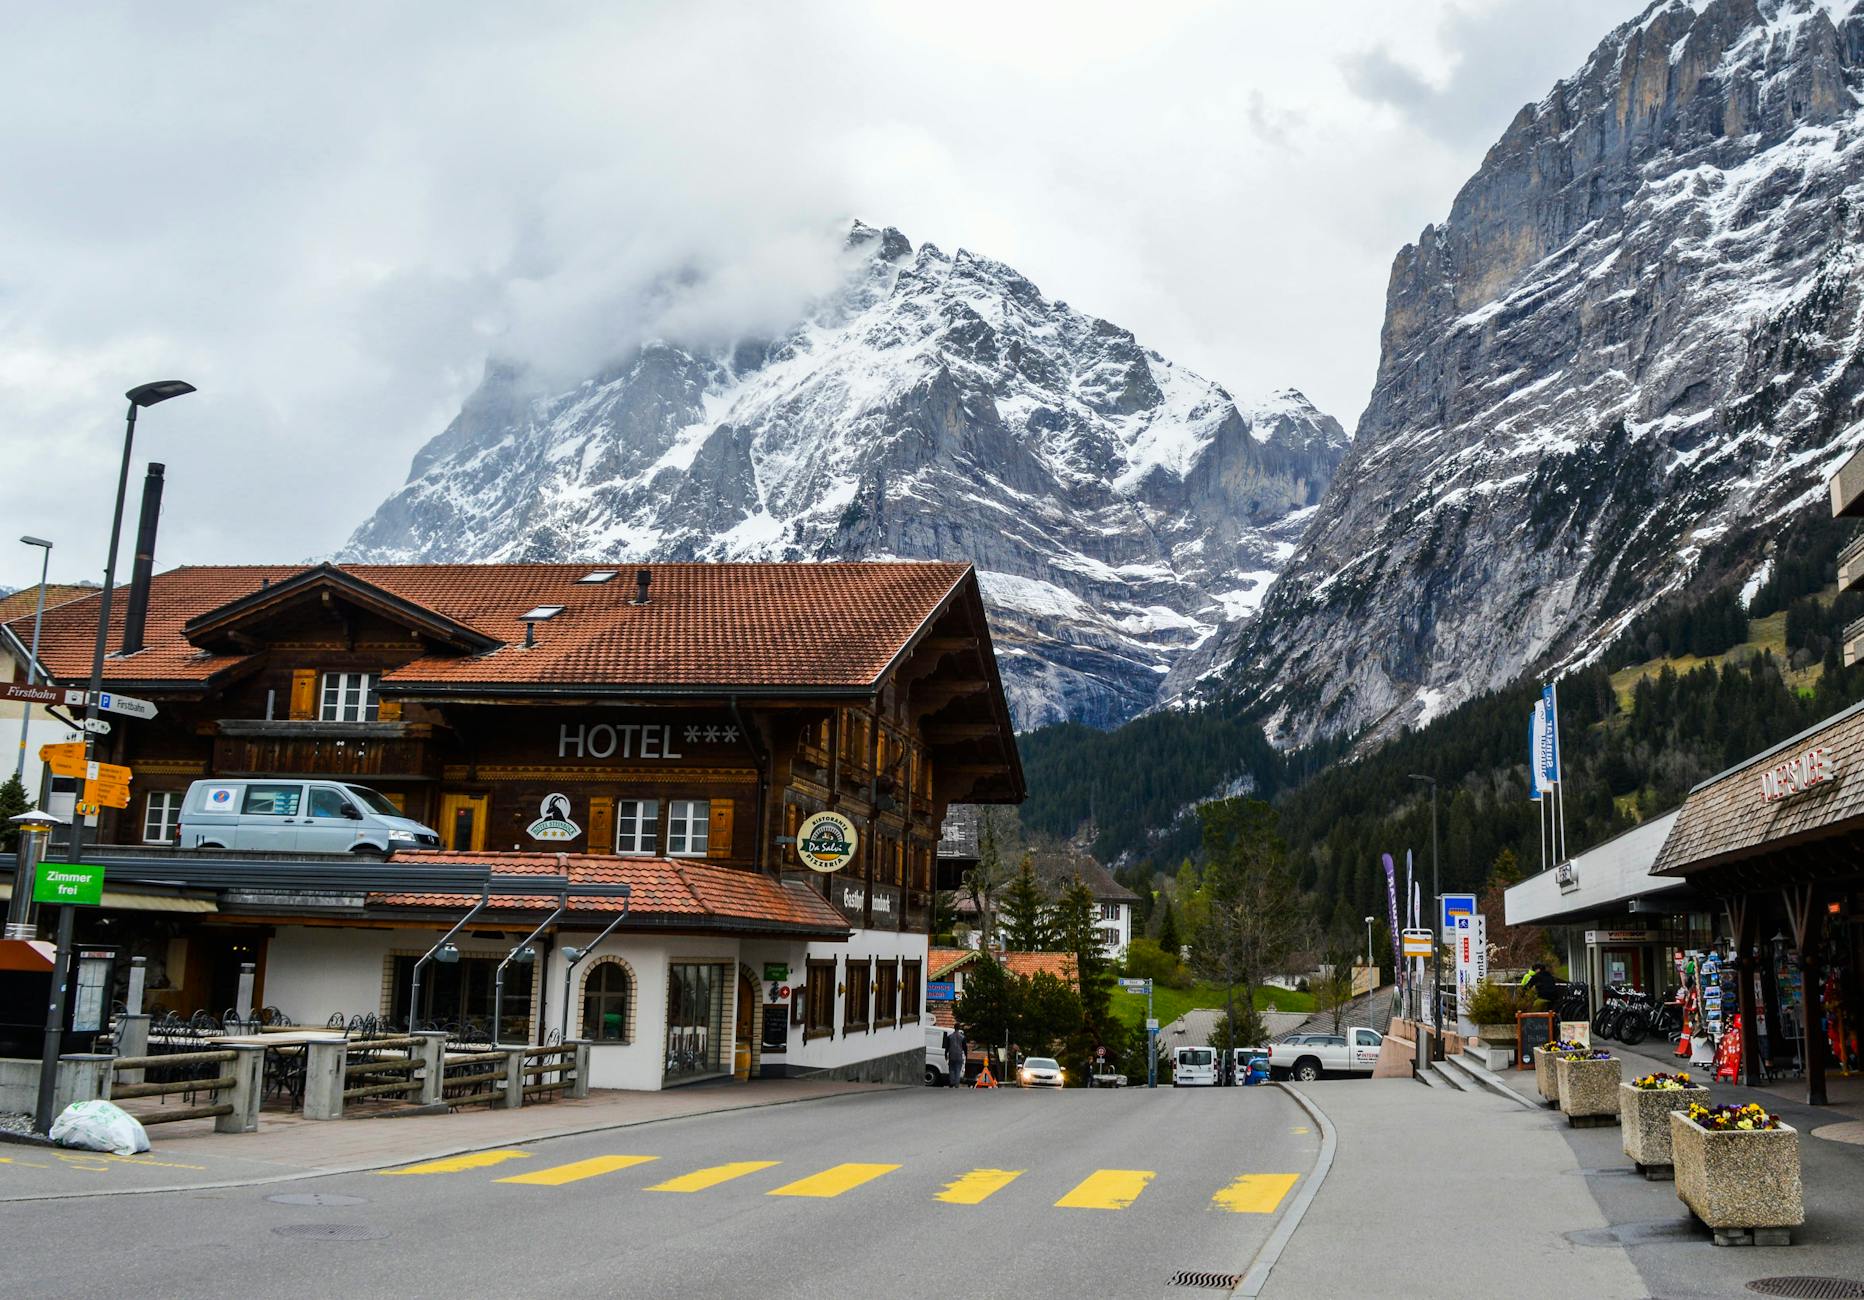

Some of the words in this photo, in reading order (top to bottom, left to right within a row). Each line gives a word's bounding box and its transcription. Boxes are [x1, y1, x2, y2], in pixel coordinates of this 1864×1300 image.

[6, 686, 57, 700] Firstbahn
[117, 699, 145, 713] Firstbahn
[558, 723, 682, 758] HOTEL
[812, 816, 848, 831] RISTORANTE
[809, 842, 820, 851] Da
[821, 842, 843, 852] Salvi
[805, 853, 844, 867] PIZZERIA
[46, 870, 92, 883] Zimmer
[57, 883, 78, 895] frei
[843, 887, 865, 913] Gasthof
[1476, 951, 1484, 984] Rental
